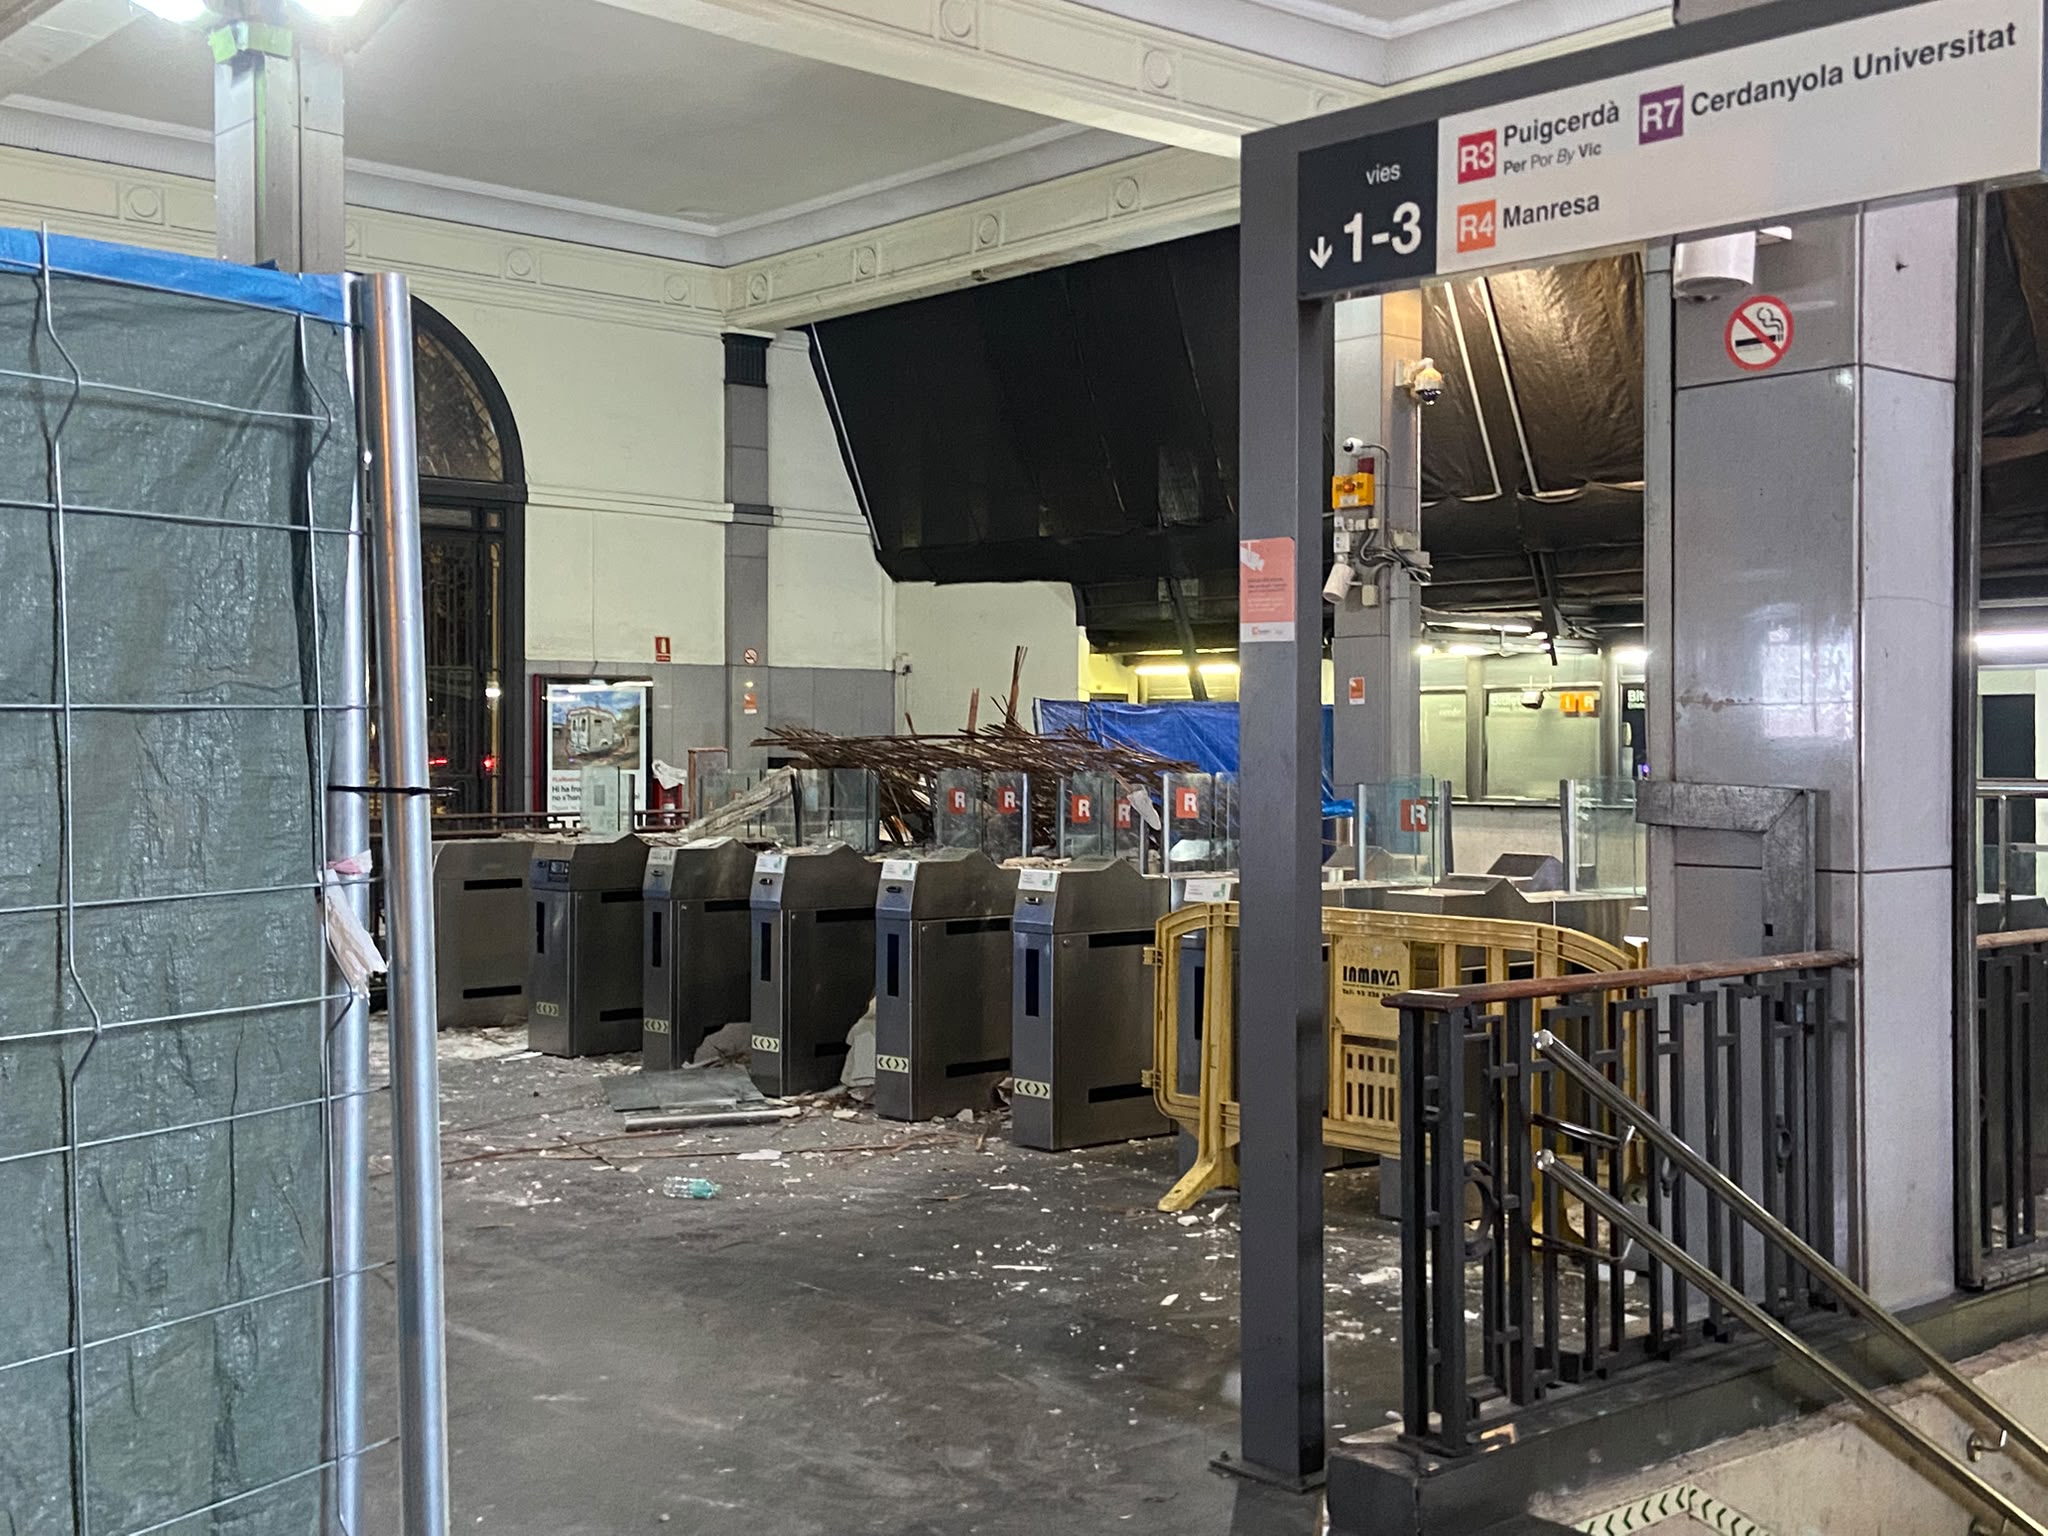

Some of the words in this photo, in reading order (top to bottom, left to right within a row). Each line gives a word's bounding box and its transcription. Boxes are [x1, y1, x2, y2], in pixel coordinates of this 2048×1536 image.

[1640, 97, 1681, 134] R7
[1691, 64, 1844, 117] Cerdanyola
[1852, 22, 2017, 81] Universitat
[1460, 141, 1495, 174] R3
[1503, 101, 1620, 147] Puigcerdà
[1503, 160, 1527, 176] Per
[1530, 153, 1552, 170] Por
[1556, 148, 1575, 166] By
[1578, 142, 1602, 159] Vic
[1365, 162, 1402, 186] vies
[1459, 213, 1495, 243] R4
[1503, 194, 1601, 229] Manresa
[1343, 201, 1423, 264] 1-3
[954, 791, 966, 809] R
[1004, 791, 1016, 808] R
[1078, 800, 1090, 818] R
[1183, 793, 1198, 812] R
[1118, 803, 1131, 822] R
[1410, 804, 1427, 825] R
